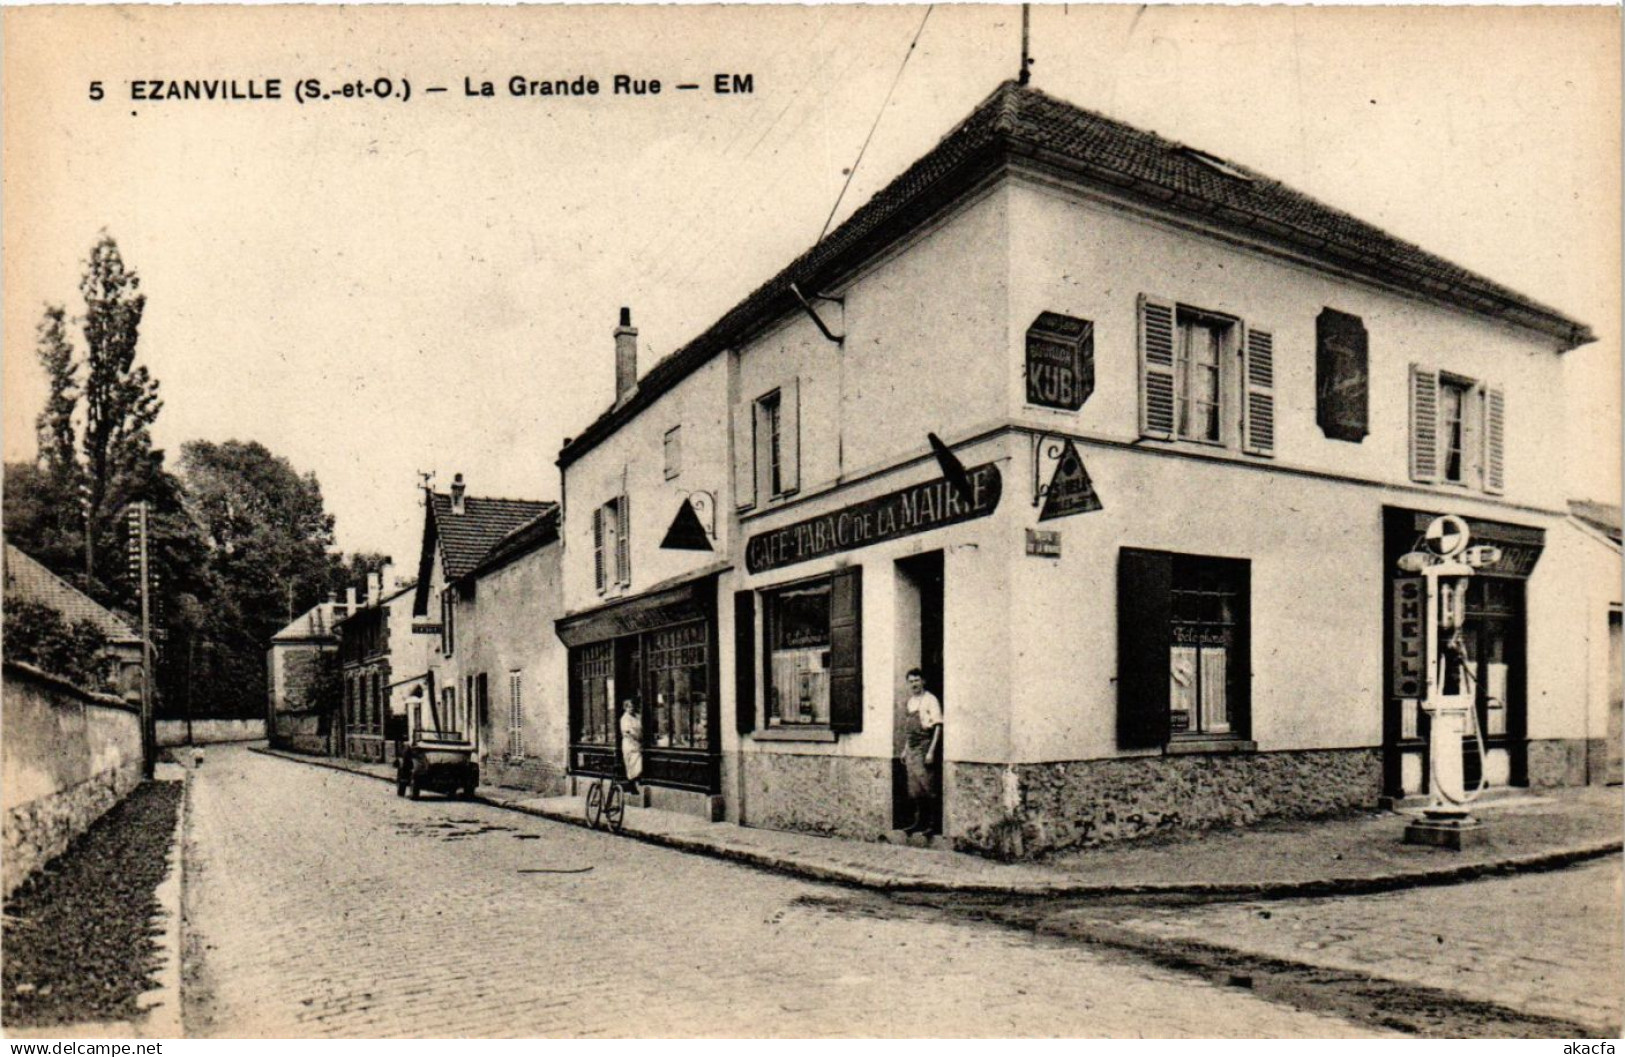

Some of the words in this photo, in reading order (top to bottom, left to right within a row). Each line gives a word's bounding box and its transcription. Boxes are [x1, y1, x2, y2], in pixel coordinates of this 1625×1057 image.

[1029, 361, 1073, 404] KUB
[853, 513, 872, 542] DE
[877, 507, 896, 536] LA
[900, 470, 988, 530] MAIRE
